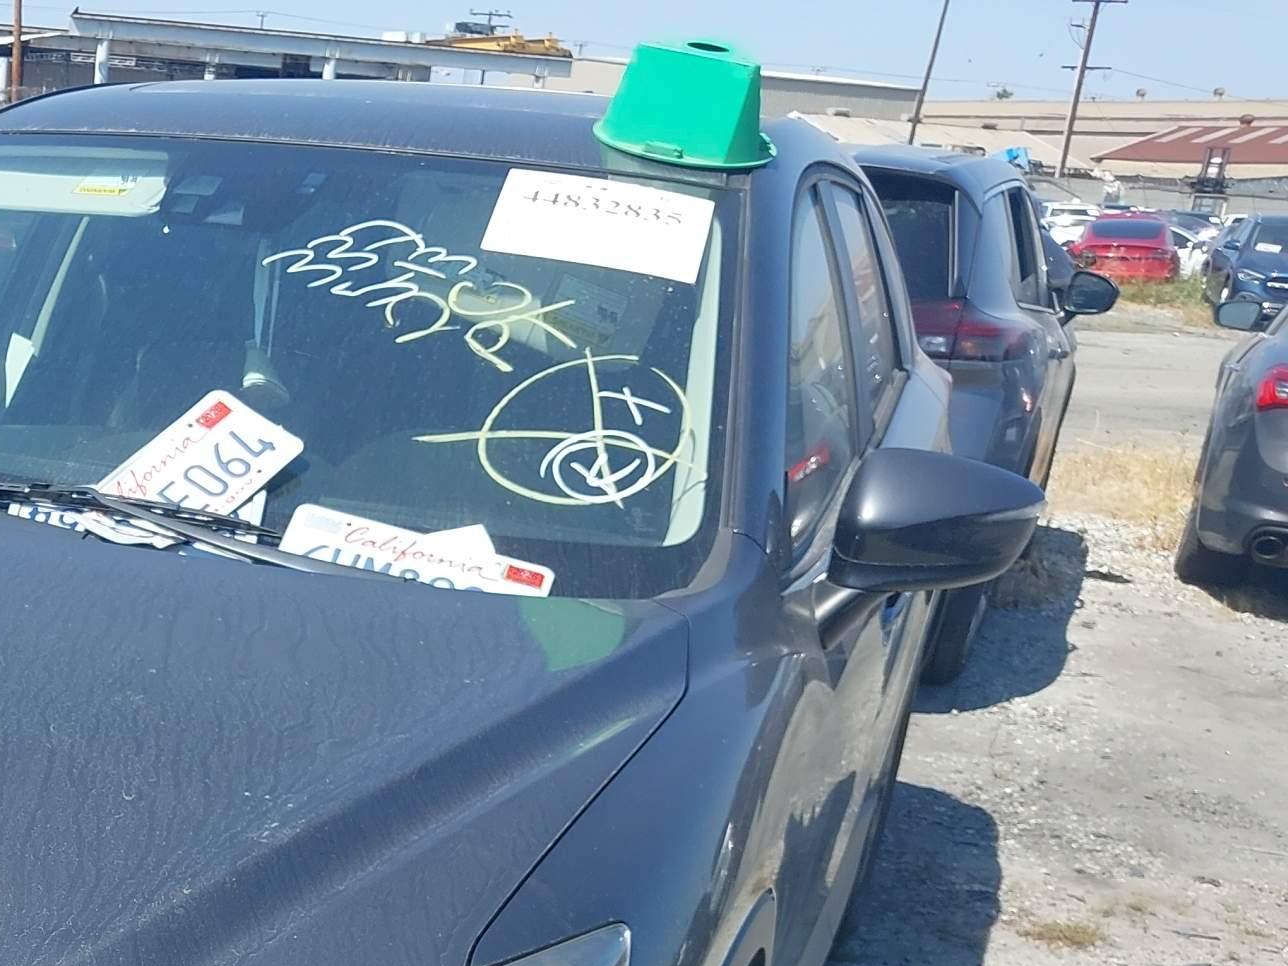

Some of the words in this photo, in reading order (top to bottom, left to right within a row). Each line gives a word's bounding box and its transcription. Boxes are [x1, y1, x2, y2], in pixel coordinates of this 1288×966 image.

[522, 189, 683, 225] 44832835
[156, 430, 276, 511] E064
[343, 526, 499, 582] California
